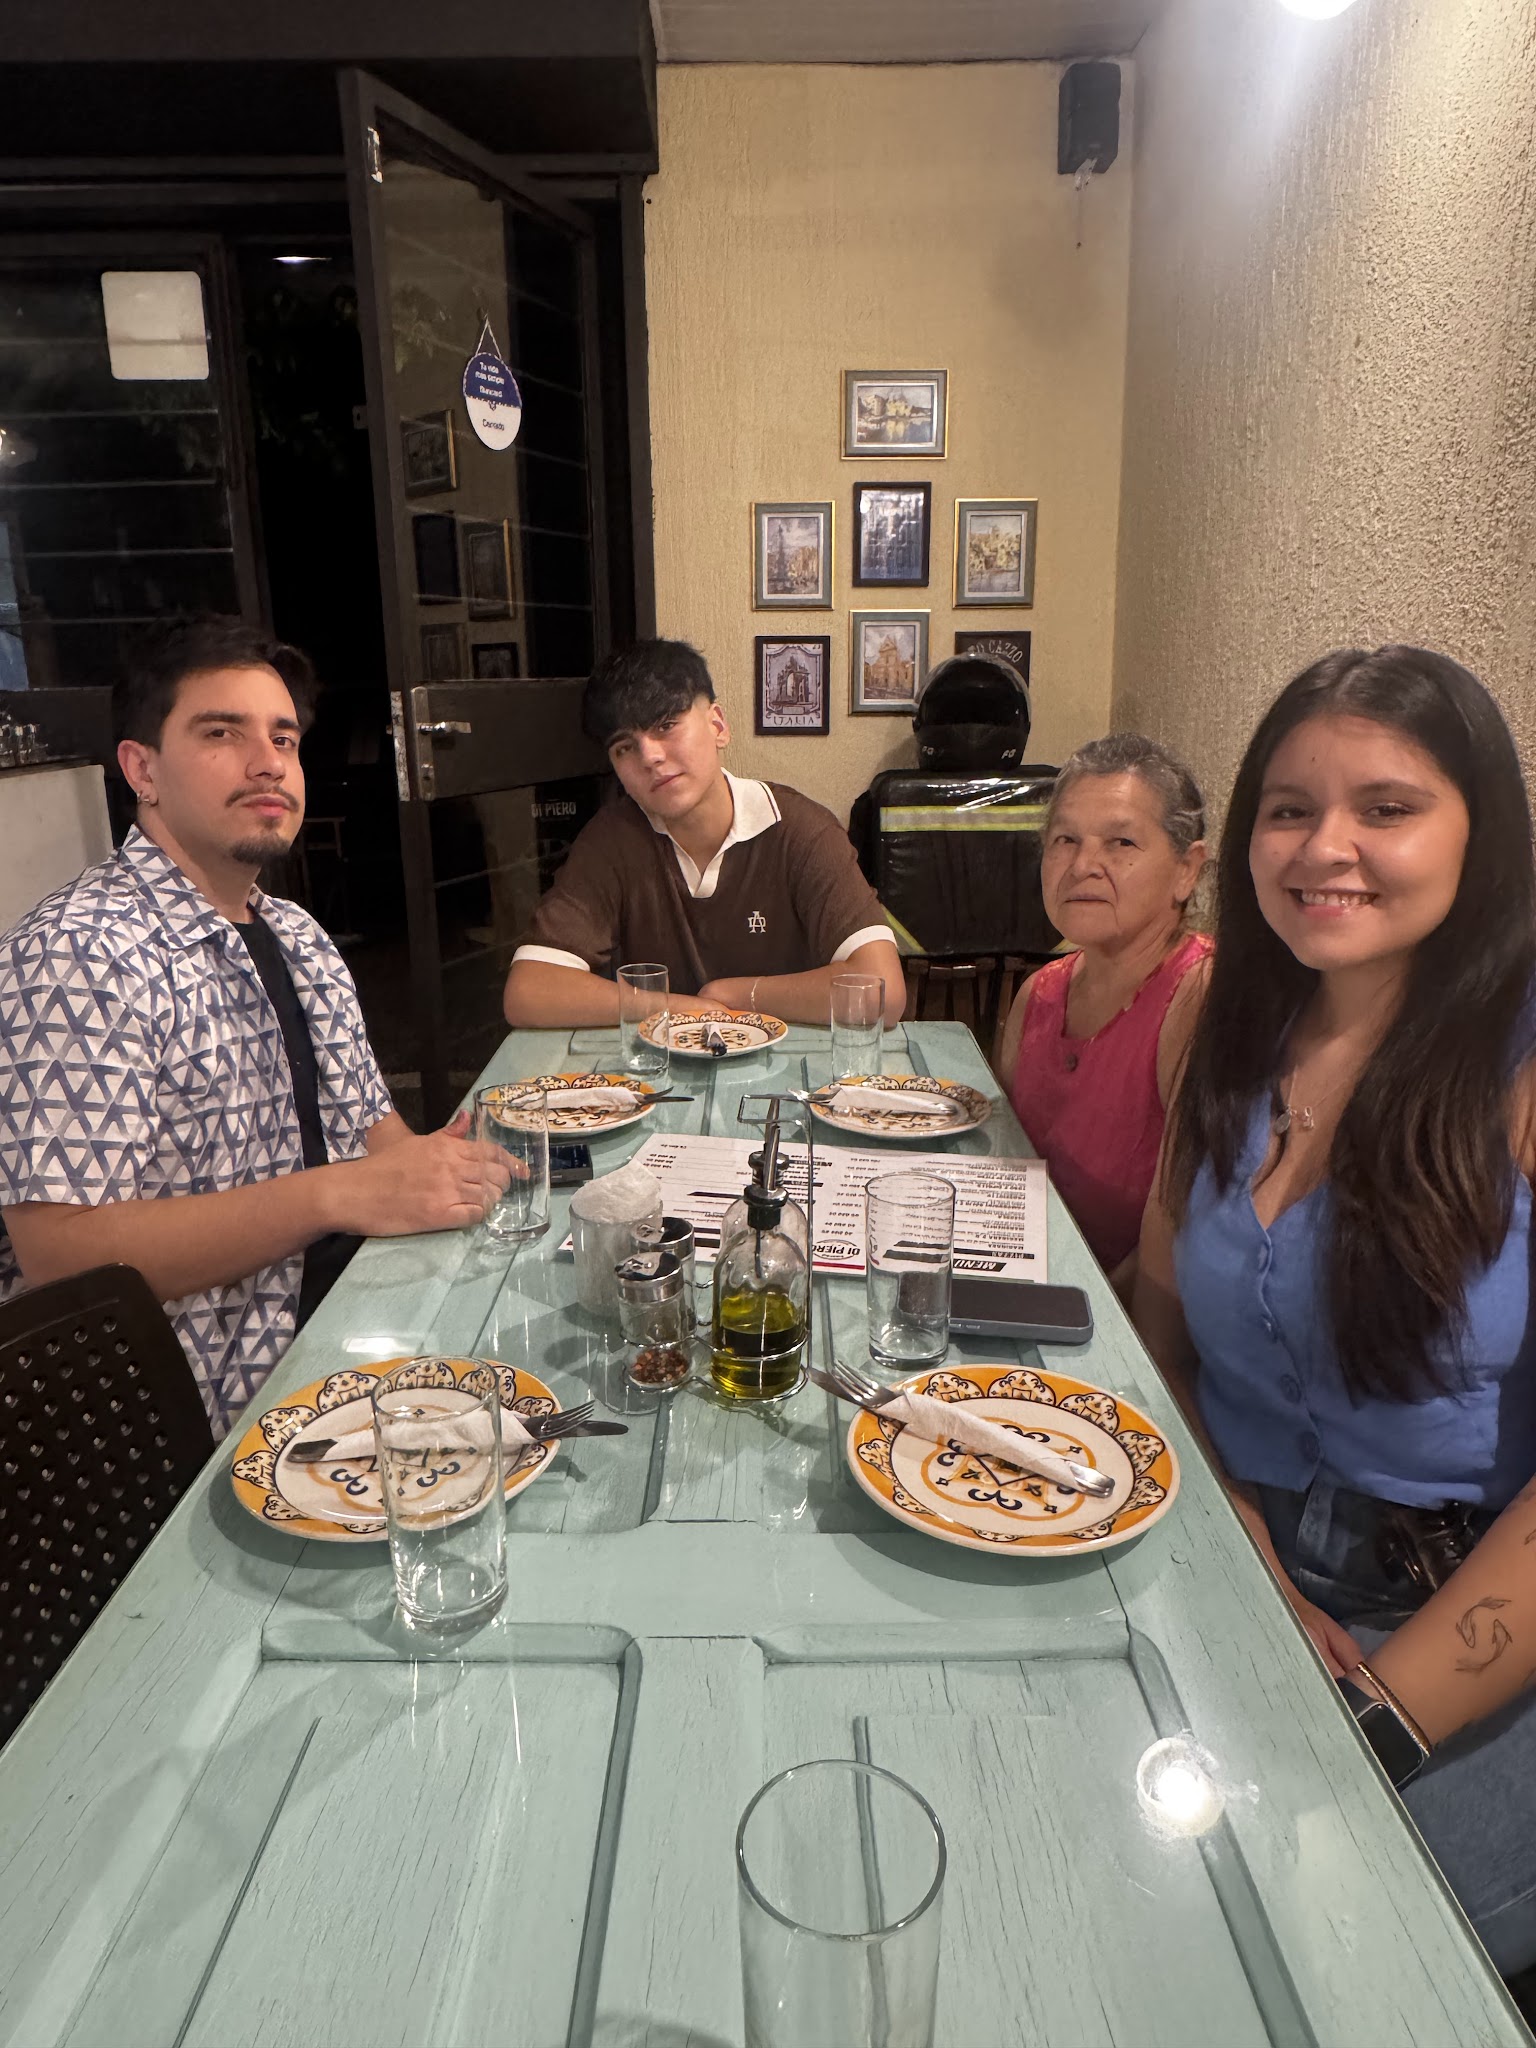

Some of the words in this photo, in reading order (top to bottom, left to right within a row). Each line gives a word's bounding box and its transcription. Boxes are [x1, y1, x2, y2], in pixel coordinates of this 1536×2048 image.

[545, 801, 577, 817] PIERO
[846, 1247, 861, 1256] DI
[954, 1259, 997, 1271] MENU
